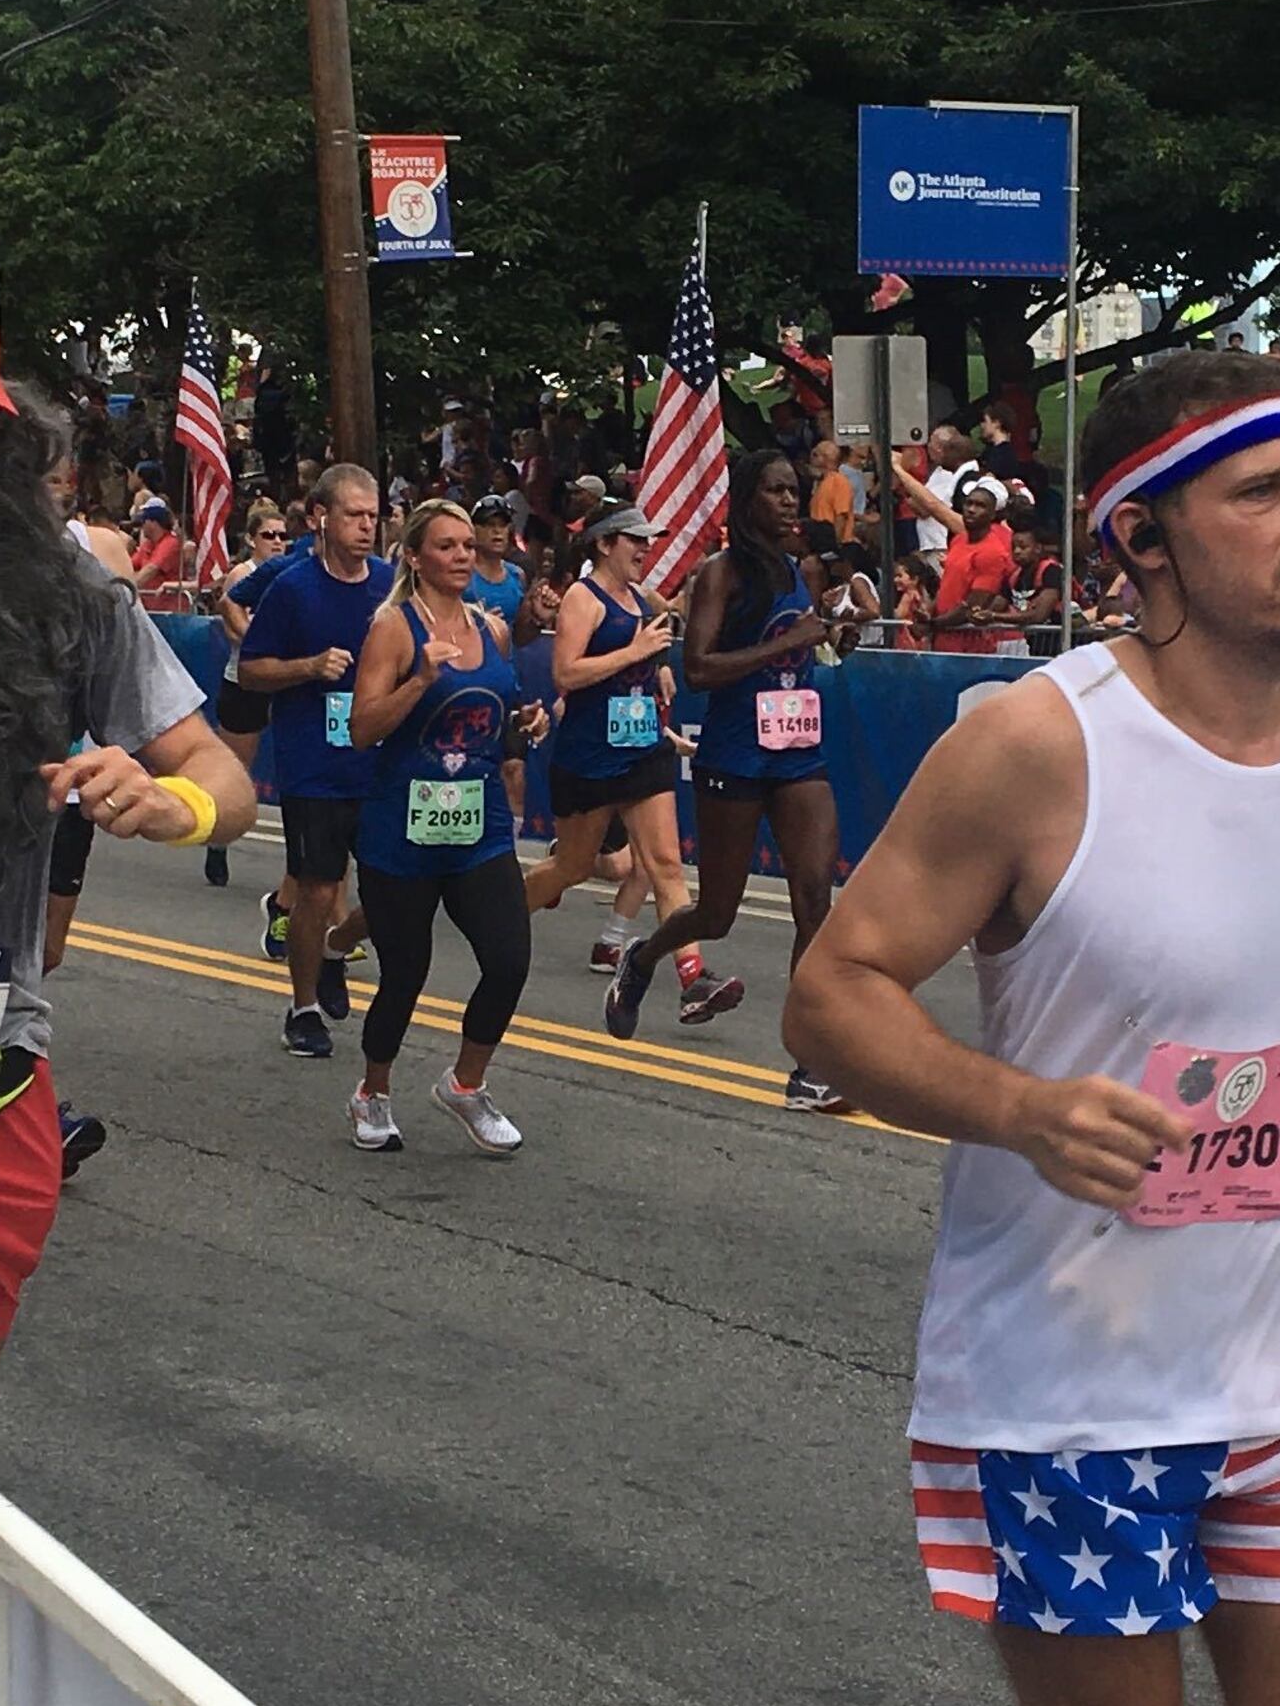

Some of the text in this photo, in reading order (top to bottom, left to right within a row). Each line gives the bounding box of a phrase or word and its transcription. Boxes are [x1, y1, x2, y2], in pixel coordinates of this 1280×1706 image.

[371, 157, 436, 167] PEACHTREE
[372, 168, 436, 179] ROAD RACE
[917, 173, 986, 187] The Atlanta
[917, 186, 1041, 201] Journal-Constitution
[378, 239, 451, 251] FOURTH OF JULY
[328, 717, 339, 731] D
[610, 720, 620, 733] D
[761, 717, 818, 734] E 14188
[411, 809, 480, 826] F 20931
